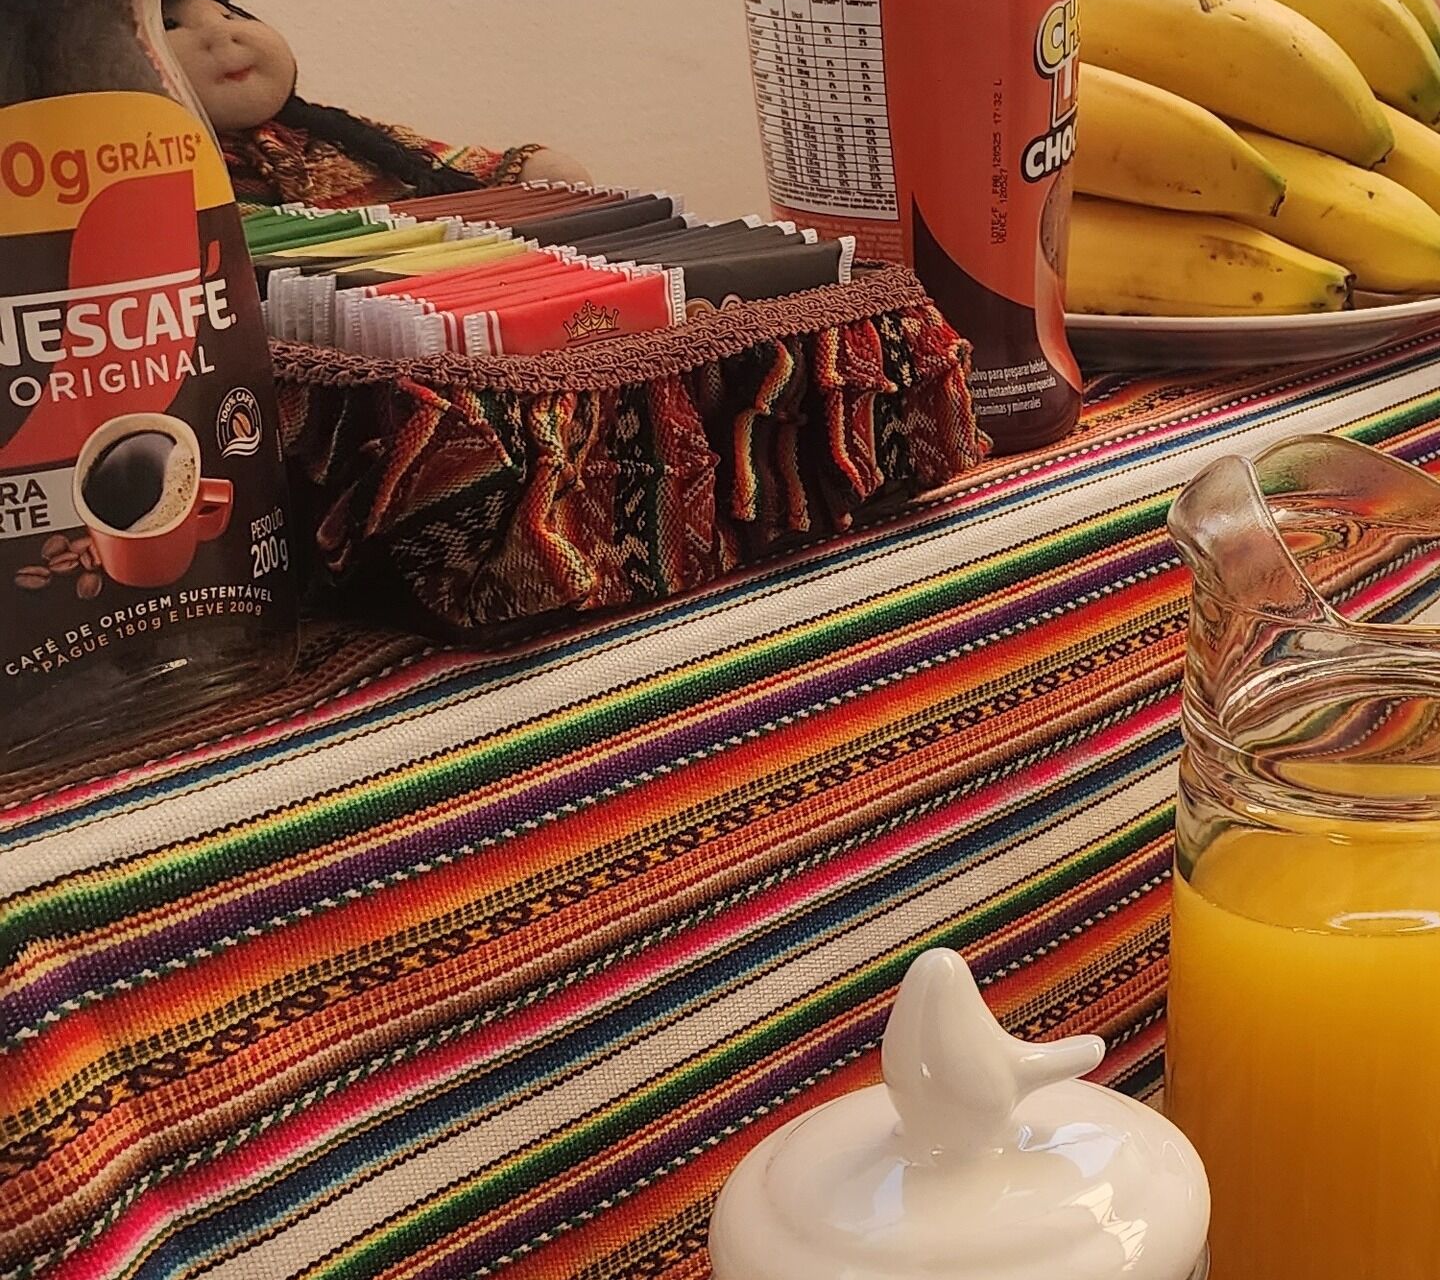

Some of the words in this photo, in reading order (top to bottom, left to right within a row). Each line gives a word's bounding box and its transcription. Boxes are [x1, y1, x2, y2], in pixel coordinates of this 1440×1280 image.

[9, 345, 215, 407] ORIGINAL
[988, 369, 1004, 384] para
[1004, 364, 1029, 381] preparar
[1012, 396, 1042, 412] minerales
[251, 515, 272, 541] PESO
[5, 638, 59, 677] CAFÉ
[65, 624, 92, 644] DE
[100, 595, 172, 629] ORIGEM
[179, 584, 273, 604] SUSTENTÁVEL
[116, 616, 162, 640] 180g
[169, 610, 180, 623] E
[186, 601, 224, 619] LEVE
[229, 601, 263, 616] 200g
